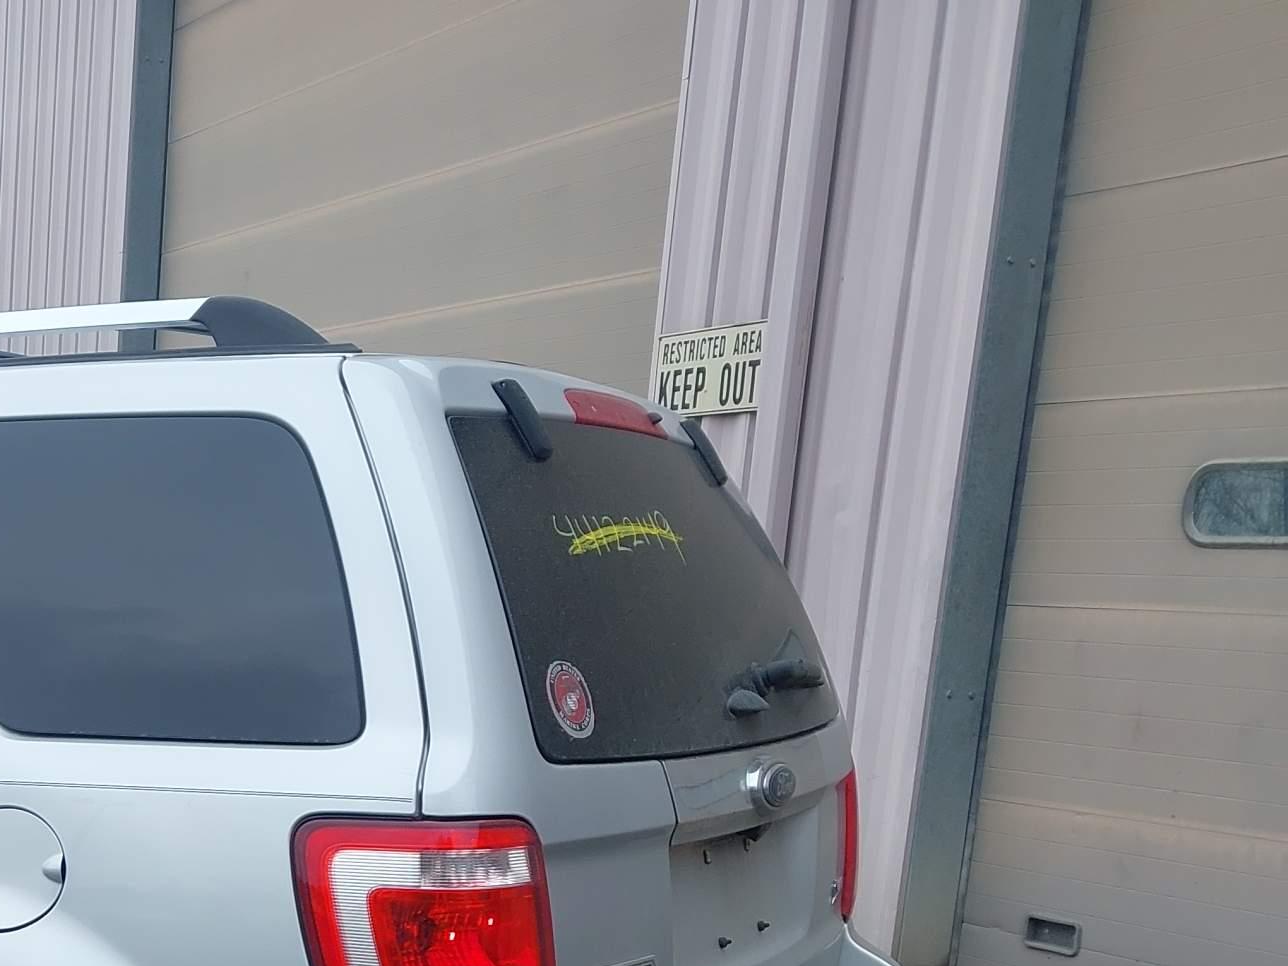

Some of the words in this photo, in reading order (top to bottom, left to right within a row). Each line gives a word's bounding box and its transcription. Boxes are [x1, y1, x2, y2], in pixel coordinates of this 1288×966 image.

[662, 335, 726, 365] RESTRICTED
[732, 330, 762, 356] AREA
[658, 366, 706, 411] KEEP
[719, 359, 761, 407] OUT
